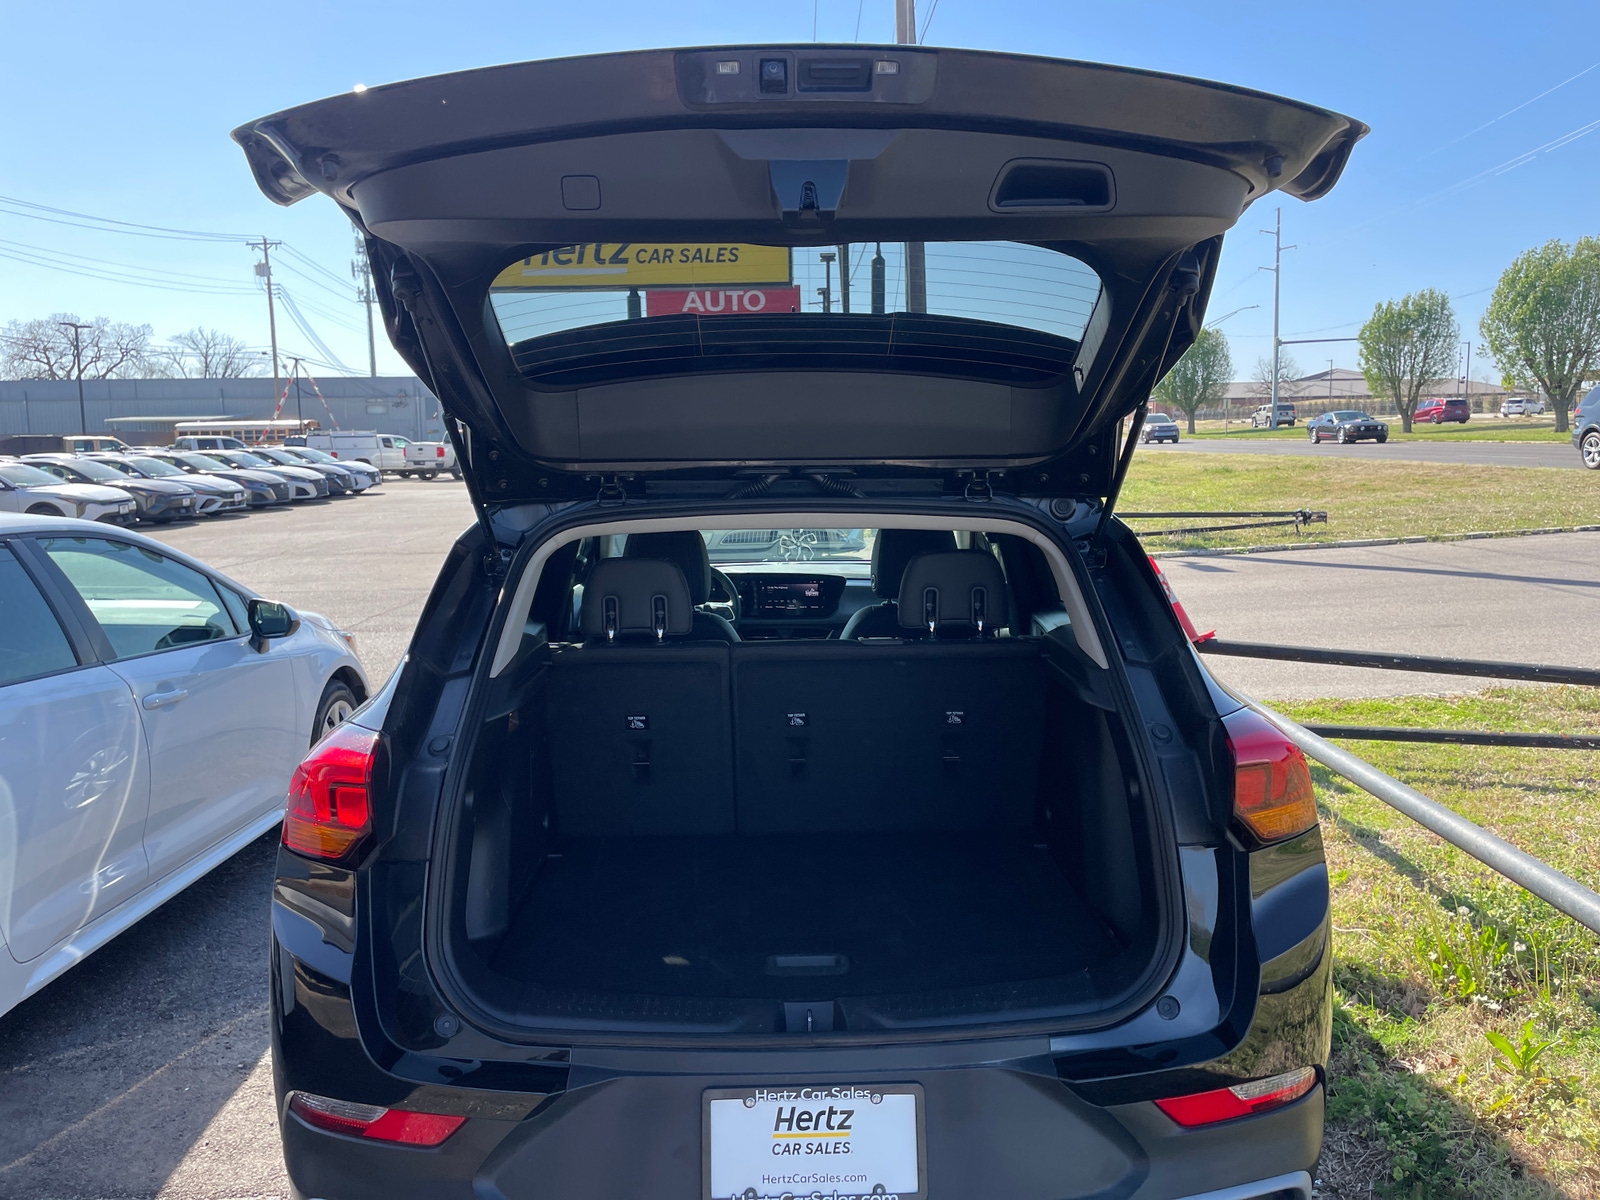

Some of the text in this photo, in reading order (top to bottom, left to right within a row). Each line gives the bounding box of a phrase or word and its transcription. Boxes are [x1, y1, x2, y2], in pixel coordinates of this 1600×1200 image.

[635, 248, 675, 264] CAR
[679, 247, 740, 263] SALES
[682, 290, 766, 312] AUTO
[755, 1086, 871, 1102] Hertz Car Sales
[773, 1105, 855, 1132] Hertz
[772, 1143, 802, 1156] CAR
[762, 1173, 867, 1184] HertzCarSales.com
